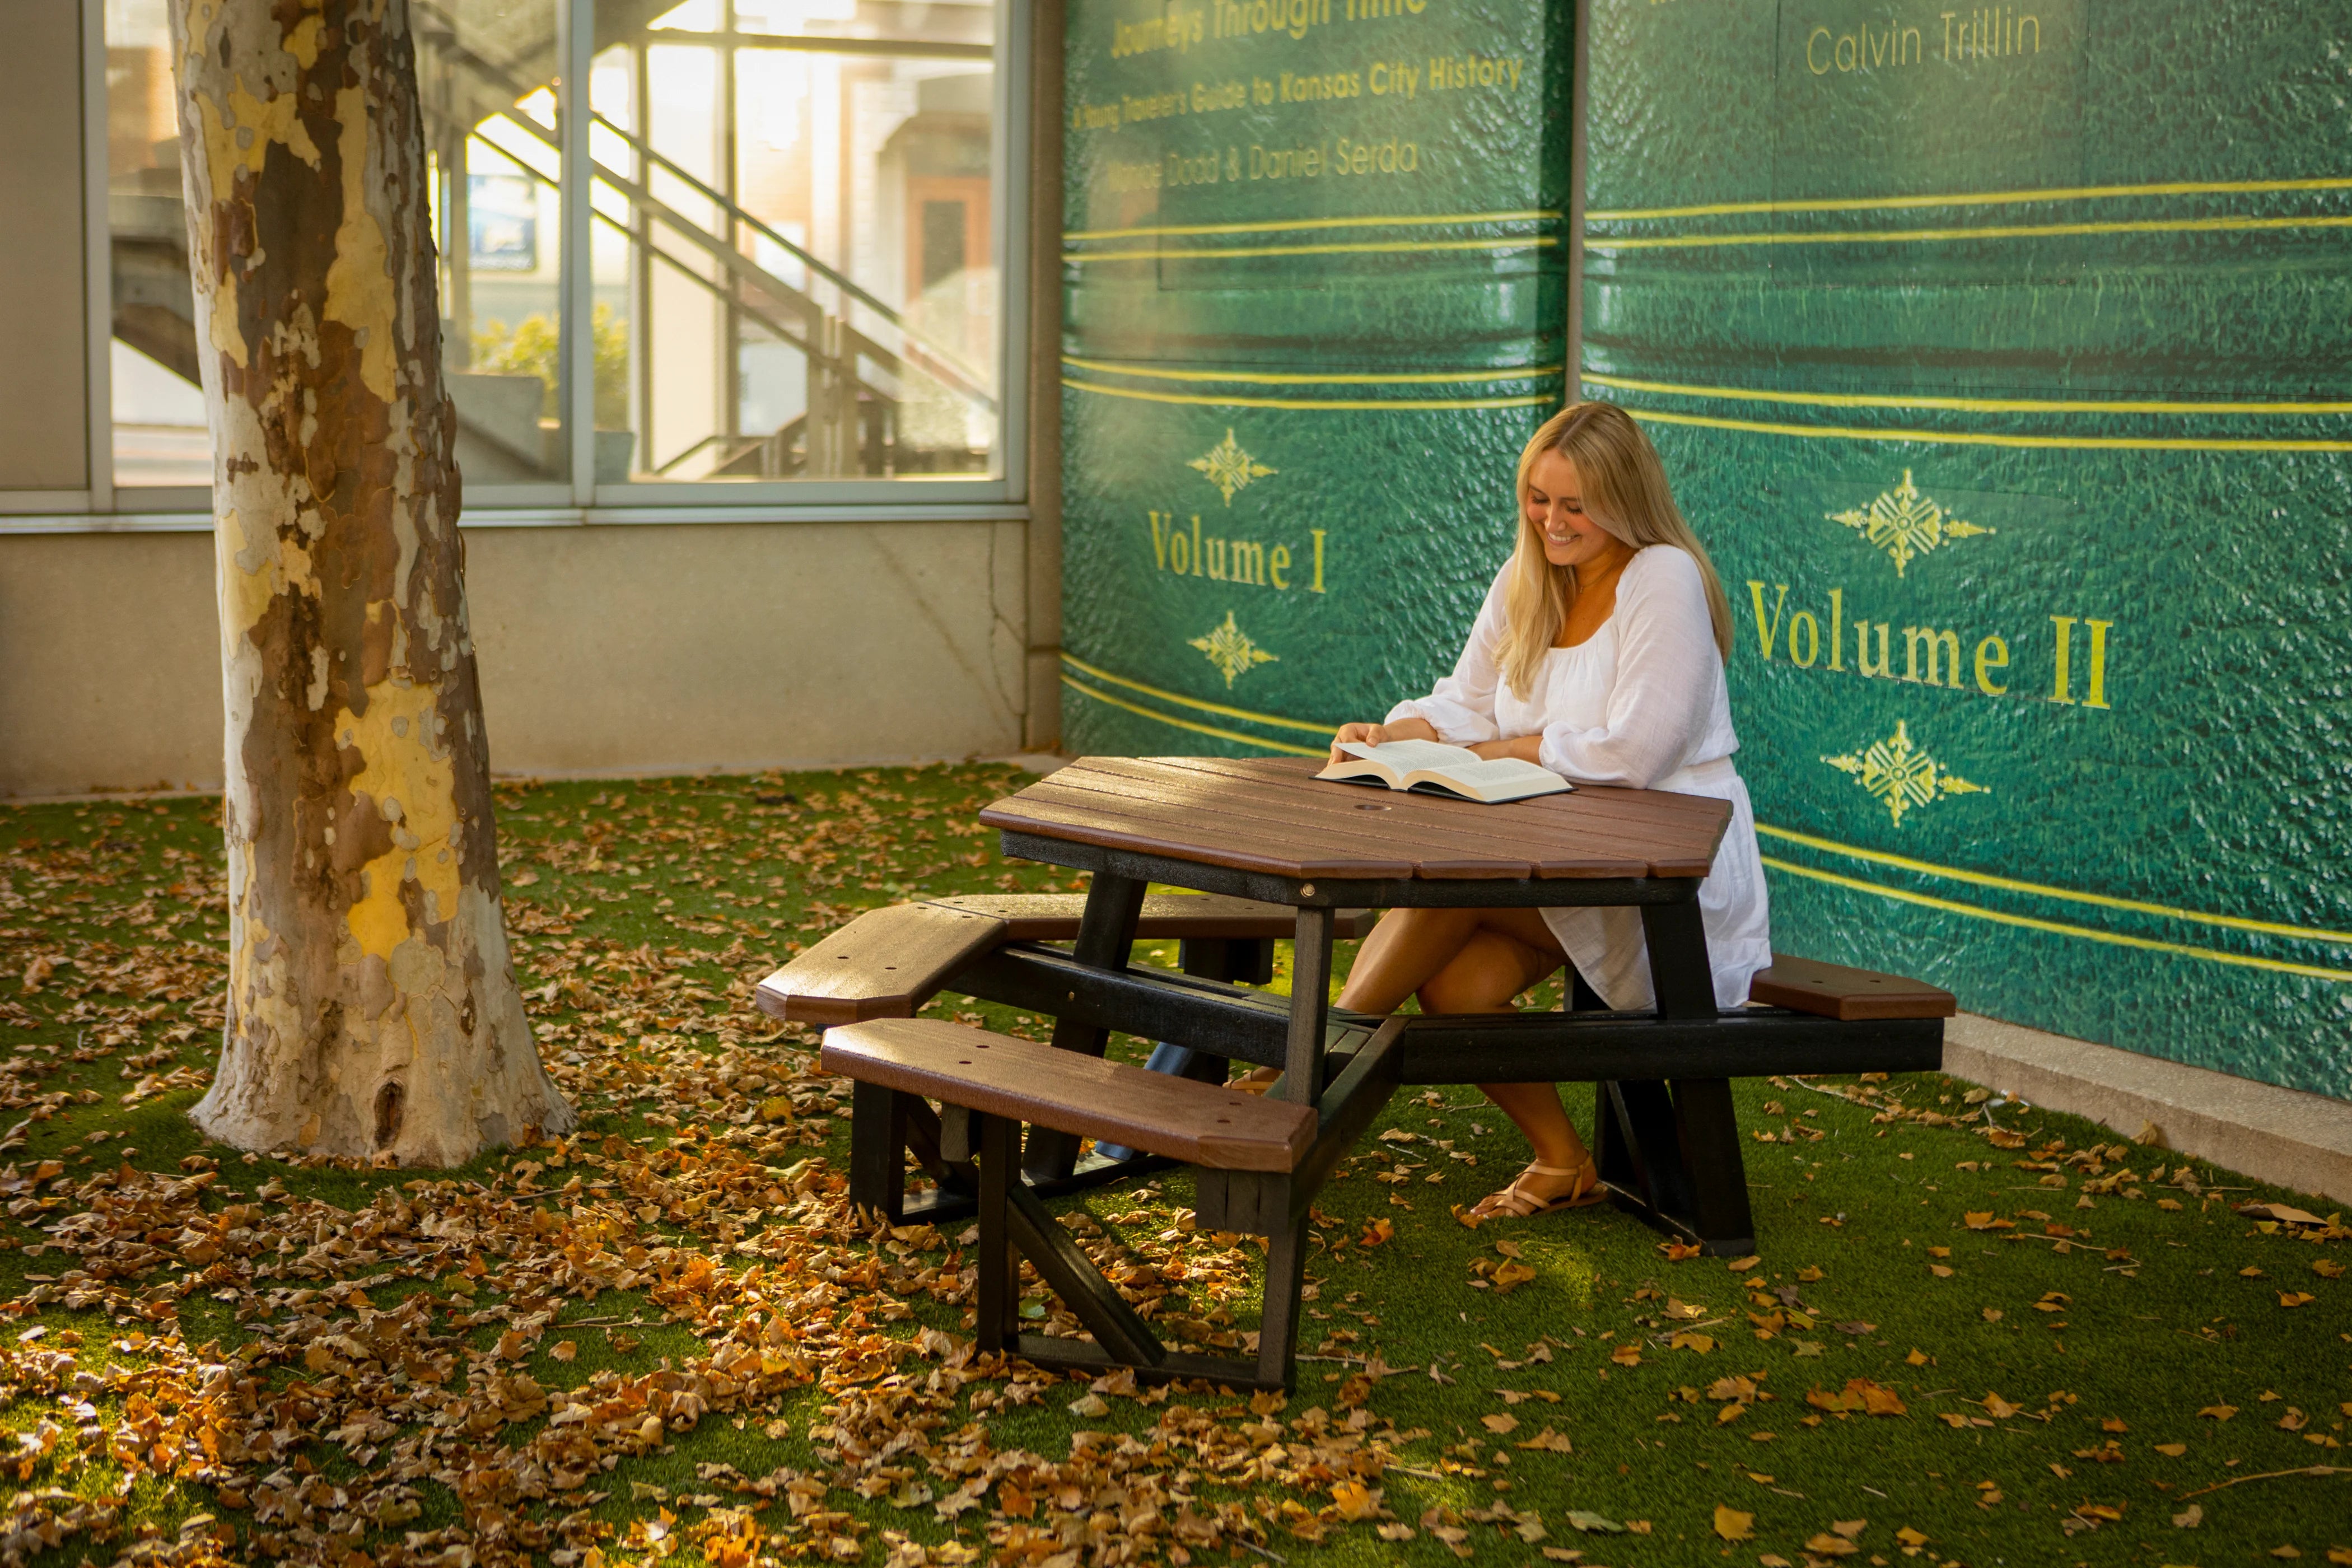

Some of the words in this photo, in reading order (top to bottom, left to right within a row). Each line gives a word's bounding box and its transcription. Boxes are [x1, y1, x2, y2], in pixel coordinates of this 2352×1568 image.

[1807, 18, 1920, 75] Calvin
[1940, 4, 2040, 61] Trillin
[1191, 82, 1246, 113] Guide
[1253, 74, 1274, 105] to
[1280, 71, 1360, 103] Kansas
[1369, 61, 1420, 100] City
[1429, 55, 1522, 92] History
[1168, 149, 1219, 186] Dodd
[1225, 145, 1239, 182] &
[1249, 141, 1328, 180] Daniel
[1336, 136, 1418, 175] Serda
[1149, 510, 1291, 590] Volume
[1310, 529, 1327, 594] I
[1746, 580, 2009, 696] Volume
[2047, 615, 2114, 710] II
